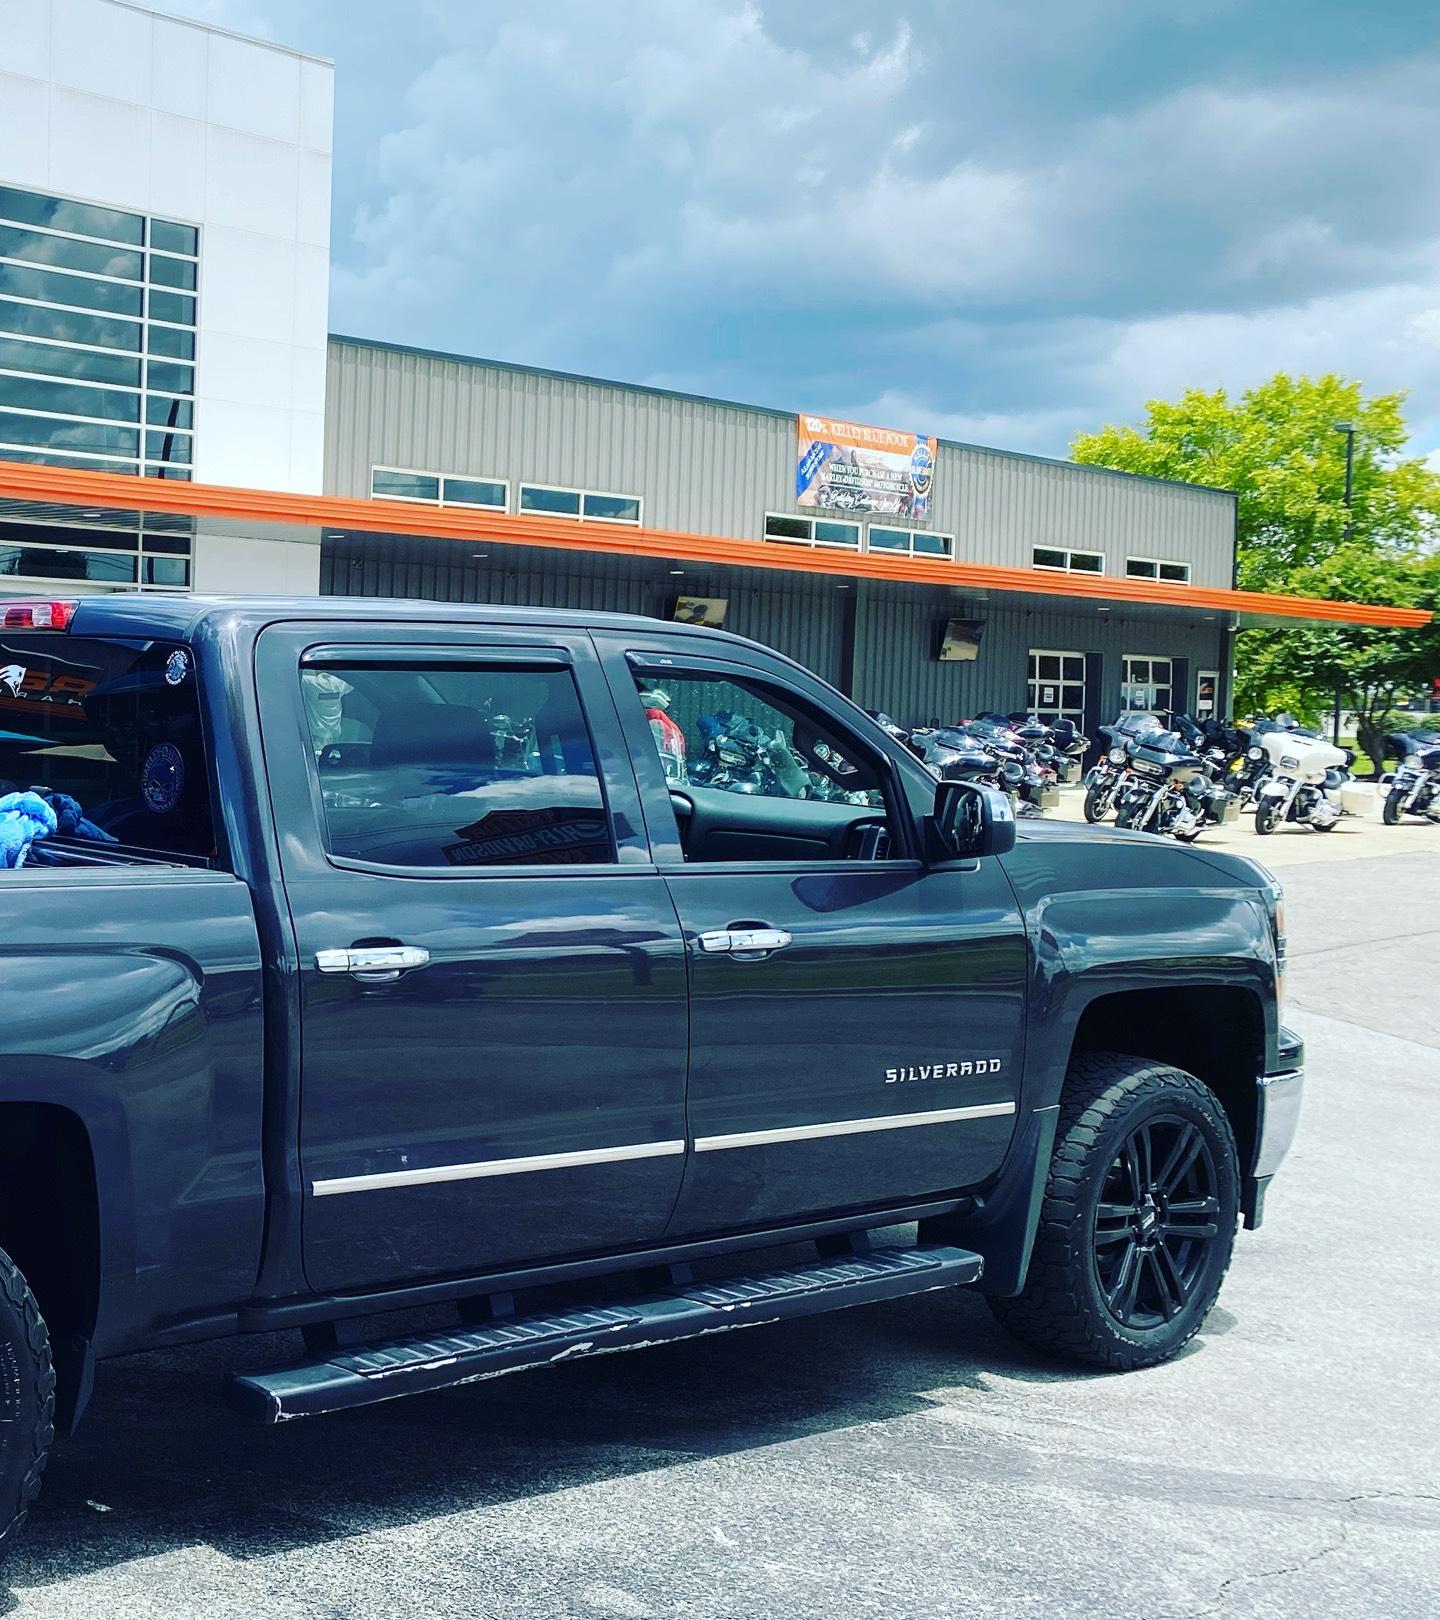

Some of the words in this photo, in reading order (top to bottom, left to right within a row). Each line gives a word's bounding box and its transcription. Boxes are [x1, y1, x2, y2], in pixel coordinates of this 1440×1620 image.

[863, 429, 885, 444] BLUE
[886, 433, 909, 447] BOOK
[847, 465, 858, 475] YOU
[885, 1059, 1001, 1083] SILVERADO
